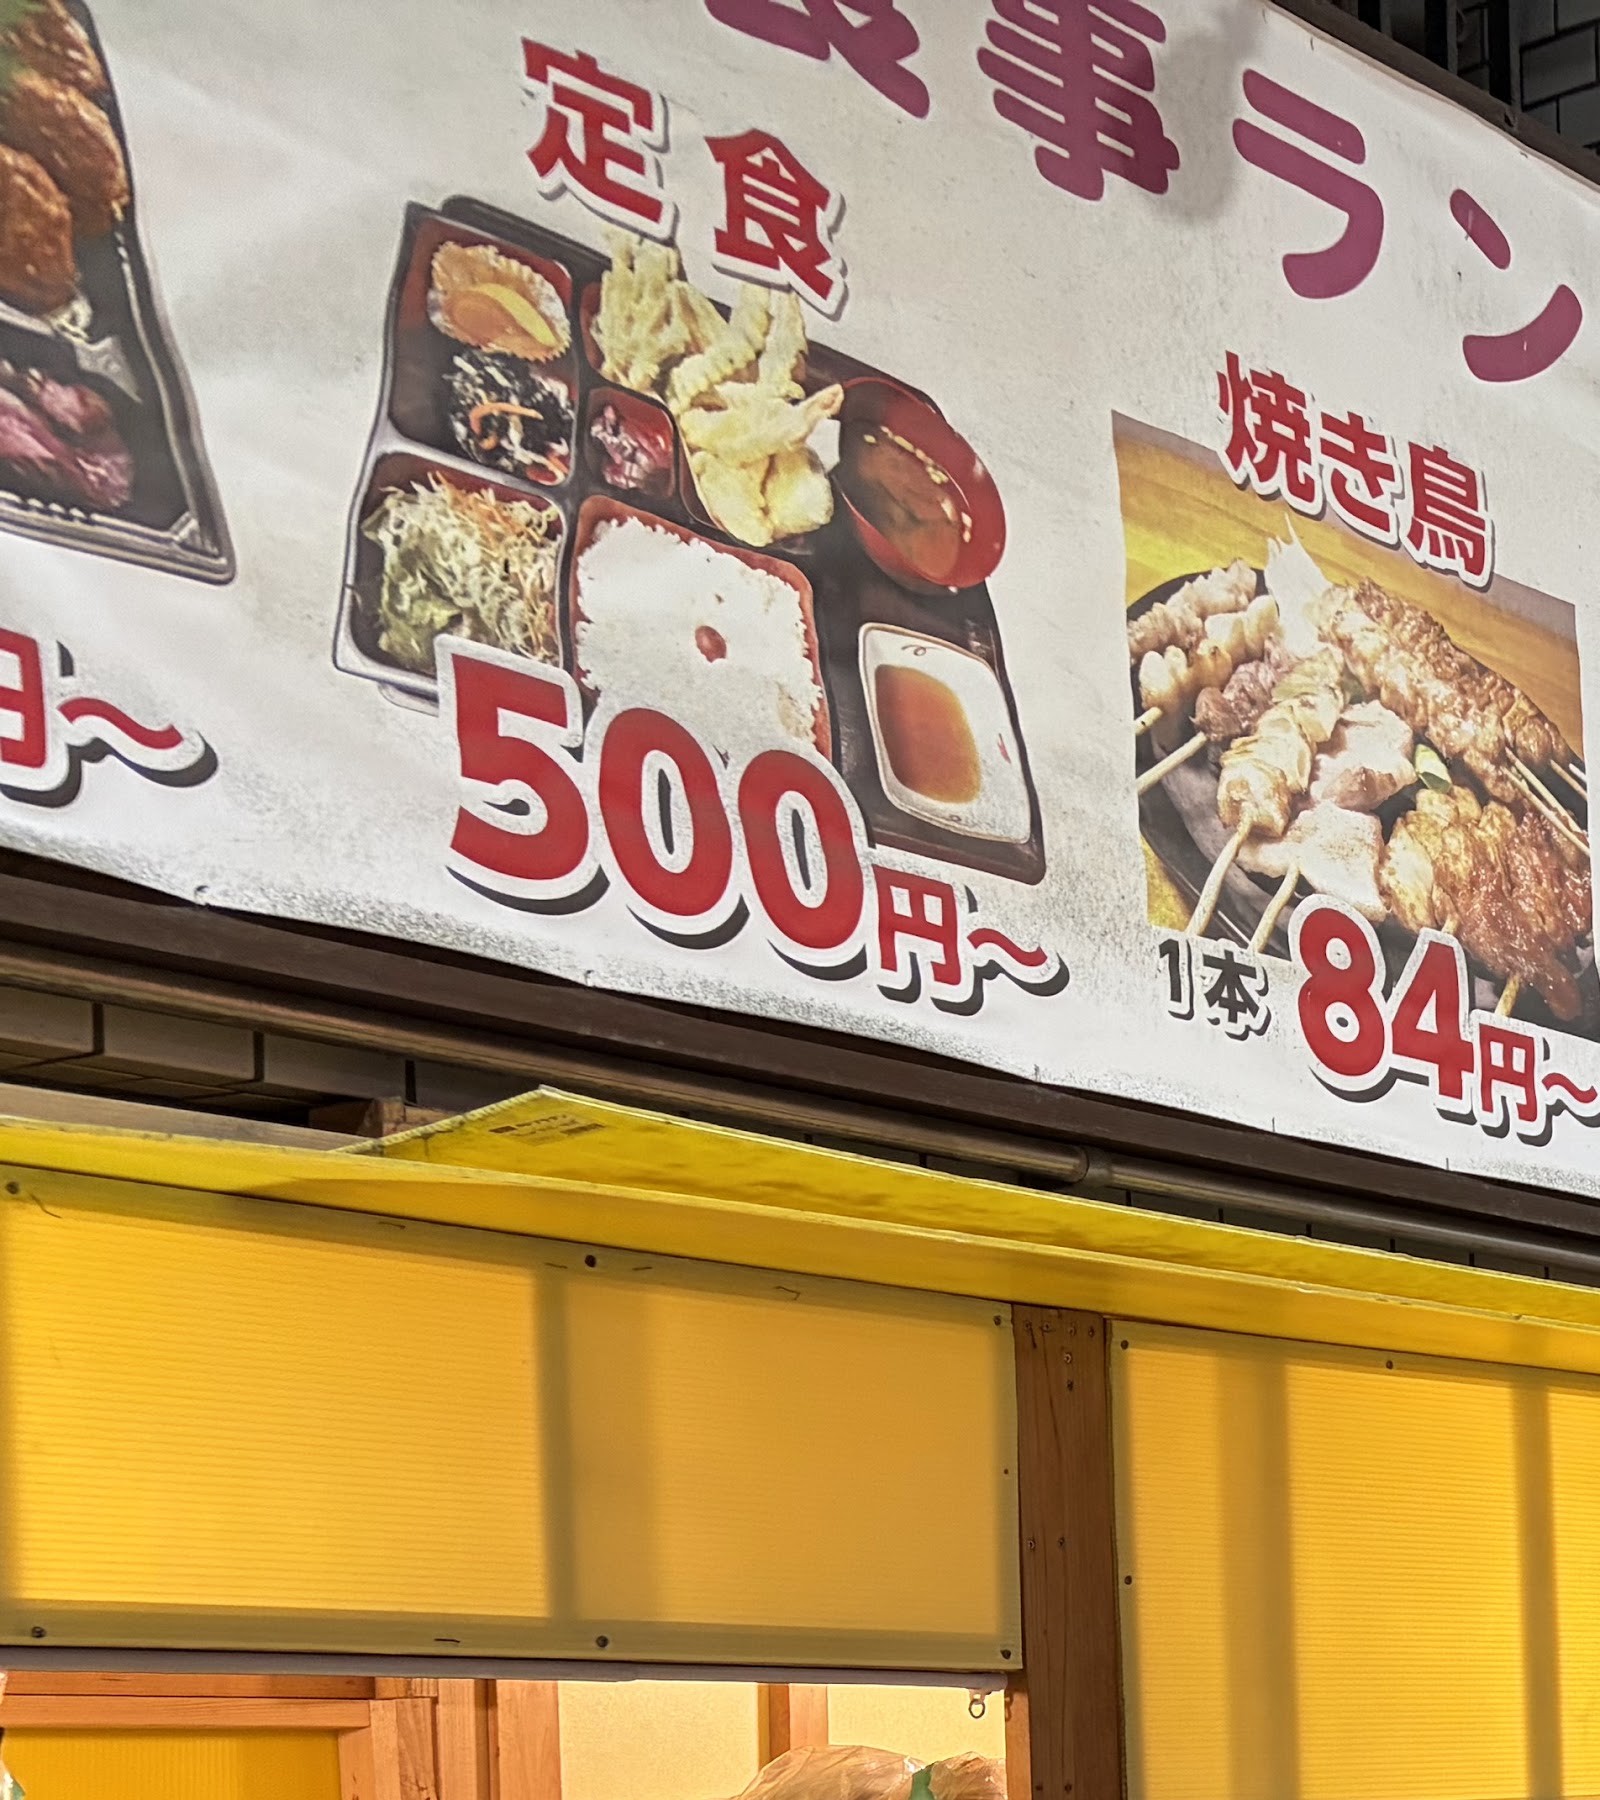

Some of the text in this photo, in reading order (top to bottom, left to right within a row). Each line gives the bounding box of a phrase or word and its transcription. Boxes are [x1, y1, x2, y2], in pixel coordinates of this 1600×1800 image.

[522, 36, 838, 302] 定食
[1219, 353, 1488, 578] 焼き鳥
[448, 653, 1050, 987] 500円～
[1159, 909, 1600, 1119] 1本 84円～
